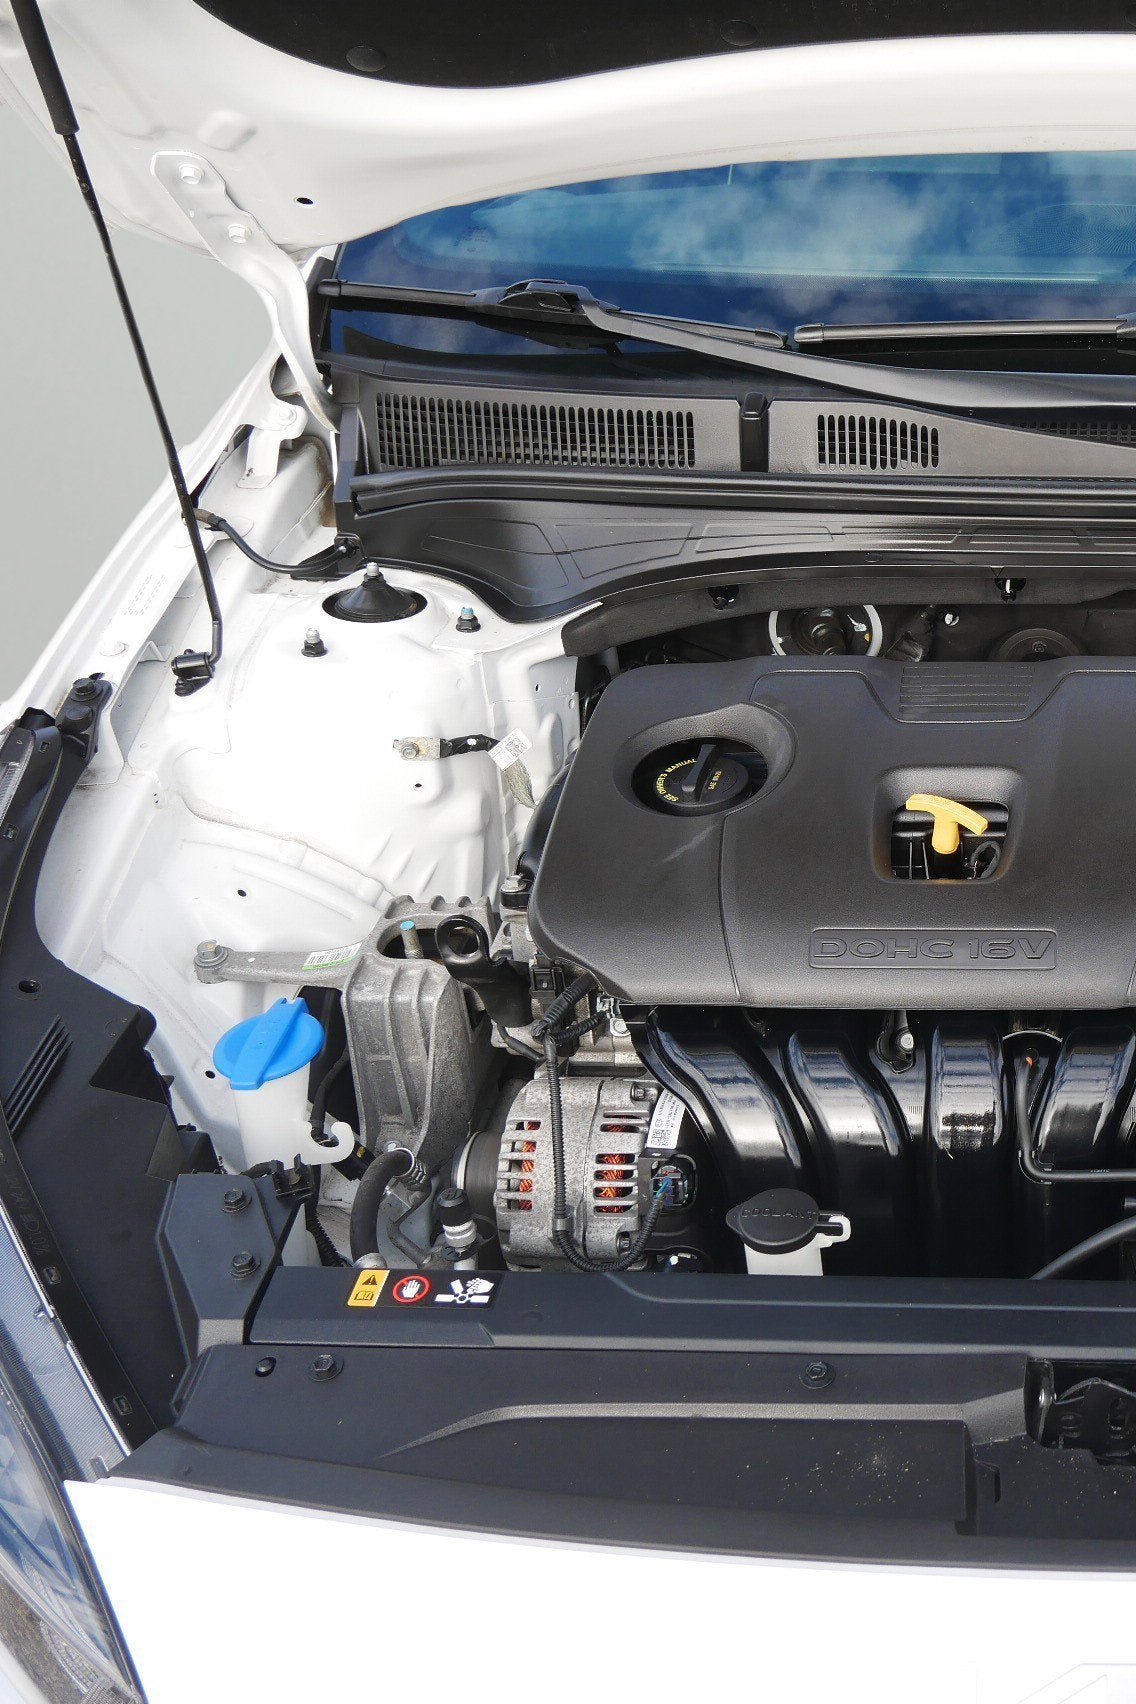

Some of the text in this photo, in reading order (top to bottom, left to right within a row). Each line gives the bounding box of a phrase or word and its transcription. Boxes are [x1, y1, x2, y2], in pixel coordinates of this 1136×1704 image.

[665, 758, 697, 773] MANUAL
[663, 793, 679, 802] SEE
[813, 937, 1053, 960] DOHC 16V
[741, 1207, 818, 1221] COOLANT
